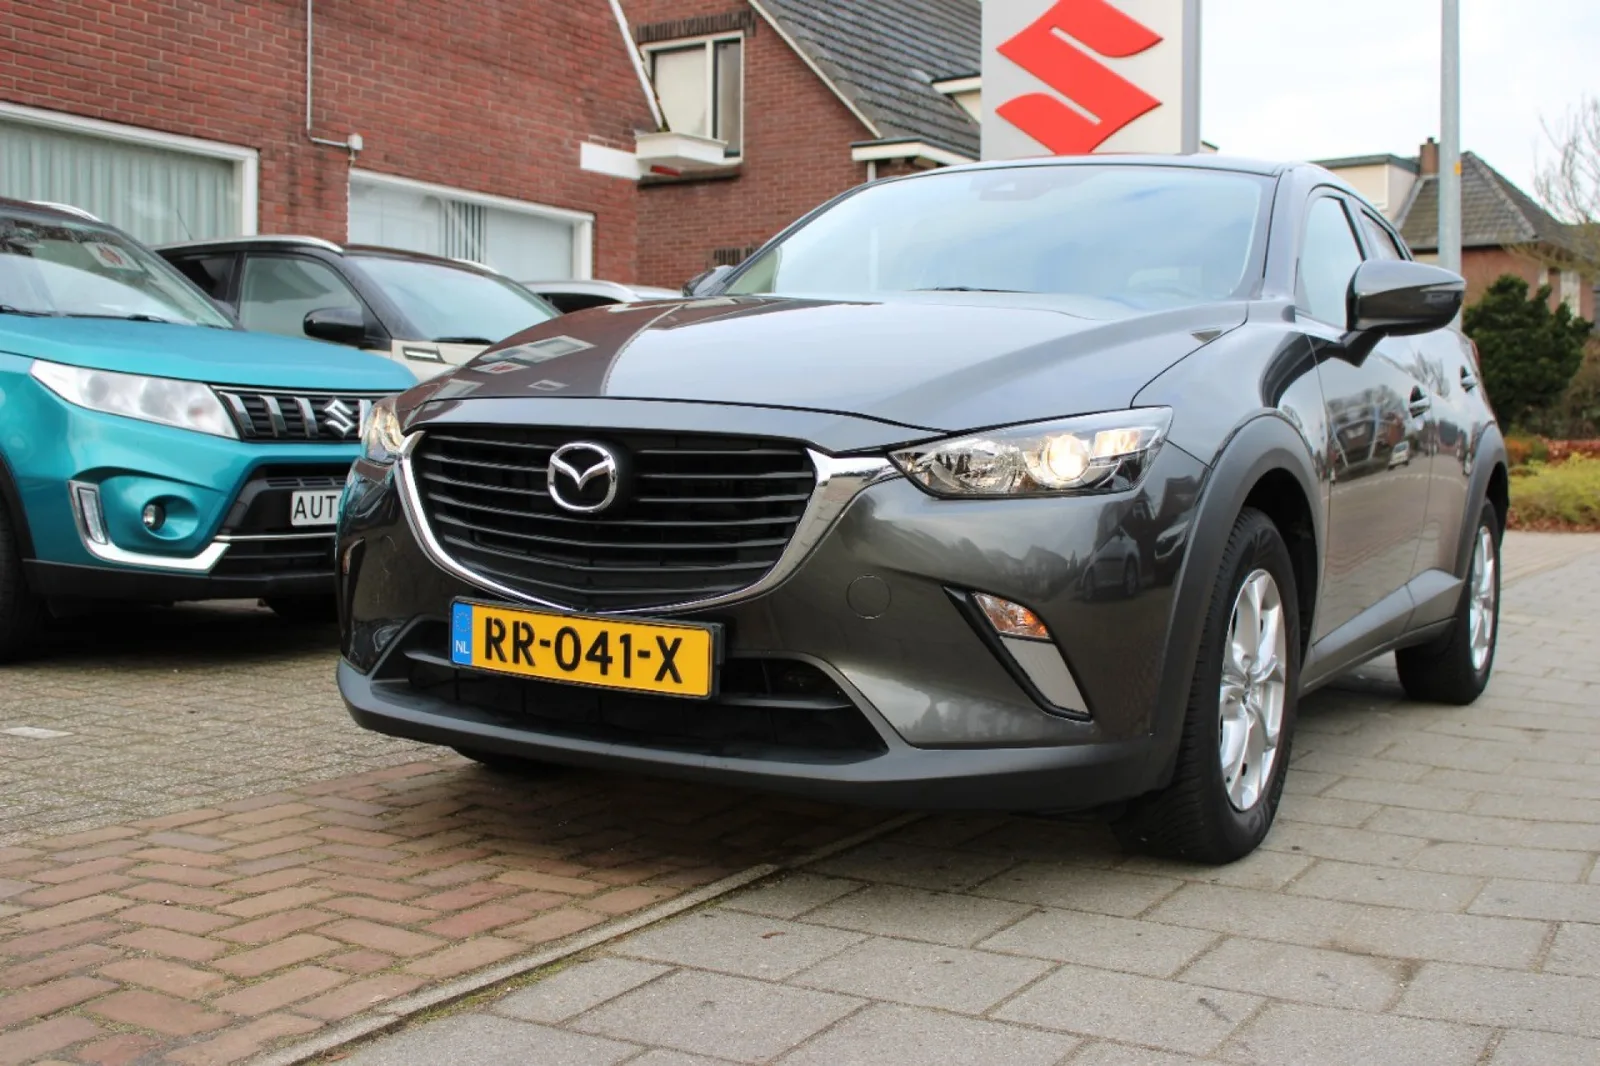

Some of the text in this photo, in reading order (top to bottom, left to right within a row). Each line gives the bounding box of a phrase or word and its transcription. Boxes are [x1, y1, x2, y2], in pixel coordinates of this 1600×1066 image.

[293, 495, 337, 519] AUT
[455, 639, 470, 654] NL
[484, 616, 683, 684] RR-041-X
